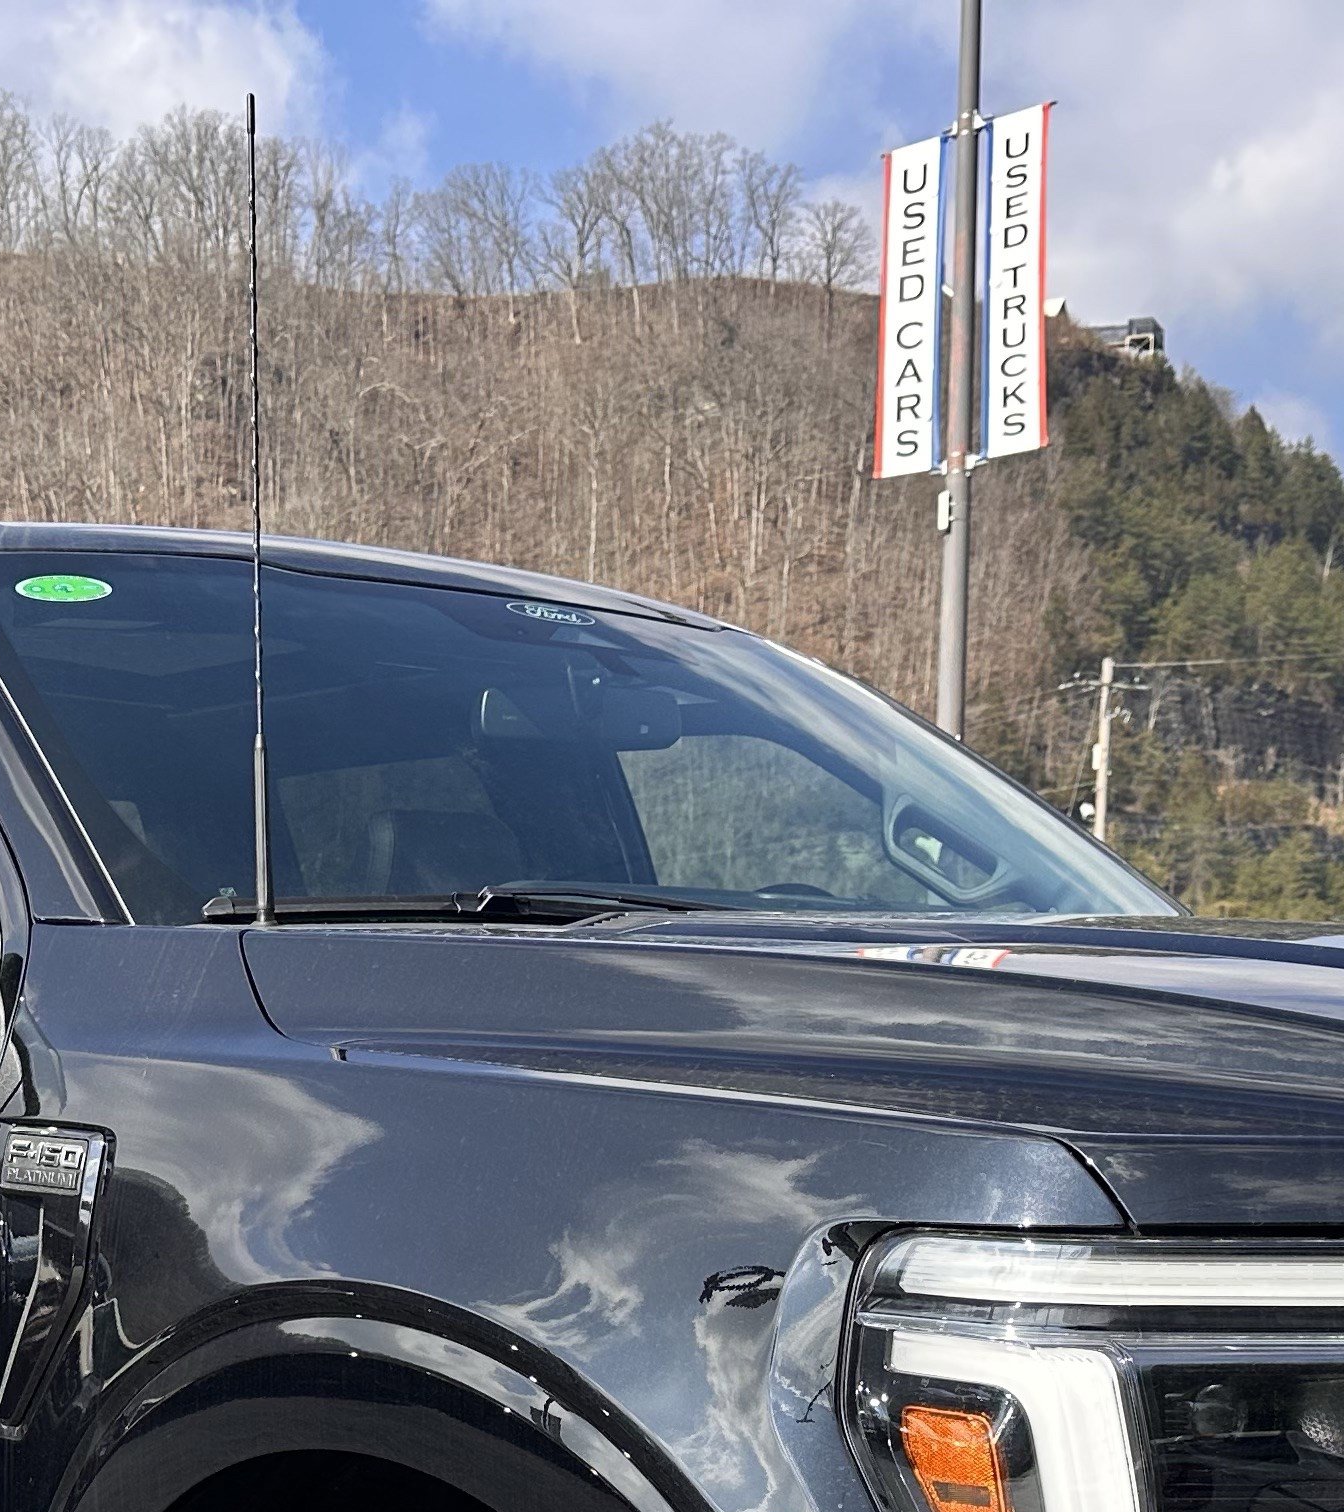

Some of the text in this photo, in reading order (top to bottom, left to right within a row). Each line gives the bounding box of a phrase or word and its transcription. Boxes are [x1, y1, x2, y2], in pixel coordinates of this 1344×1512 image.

[895, 163, 928, 457] USED CARS
[1001, 132, 1030, 436] USED TRUCKS
[524, 603, 582, 624] Ford
[6, 1166, 76, 1188] PLATINUM
